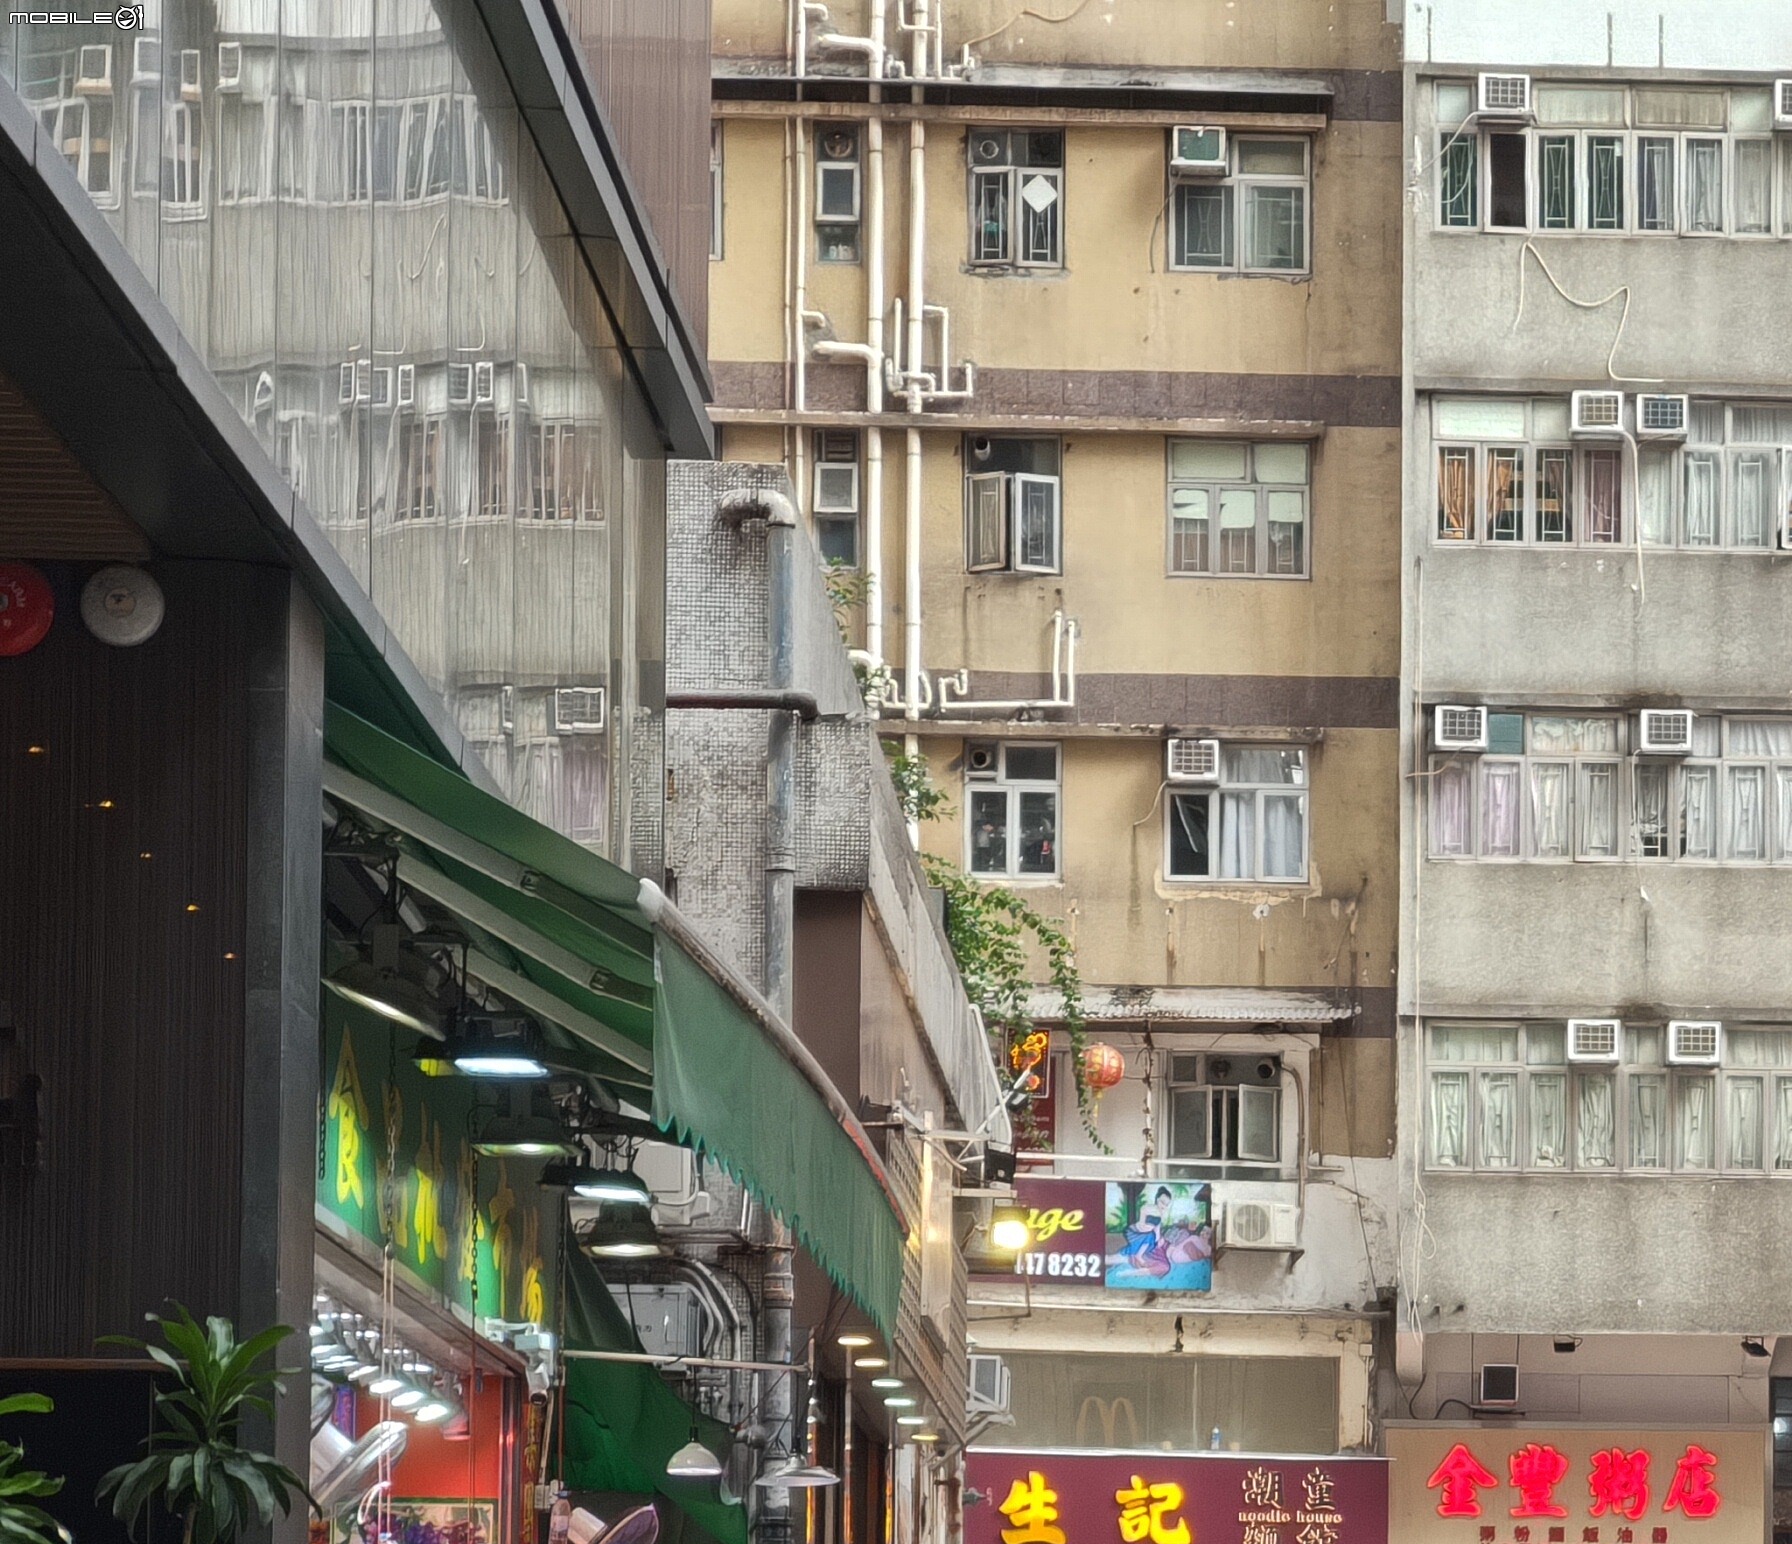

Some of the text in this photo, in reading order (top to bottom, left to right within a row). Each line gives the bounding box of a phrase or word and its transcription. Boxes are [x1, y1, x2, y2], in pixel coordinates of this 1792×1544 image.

[1048, 1253, 1101, 1278] 8232
[1427, 1442, 1722, 1520] 金豐粥店
